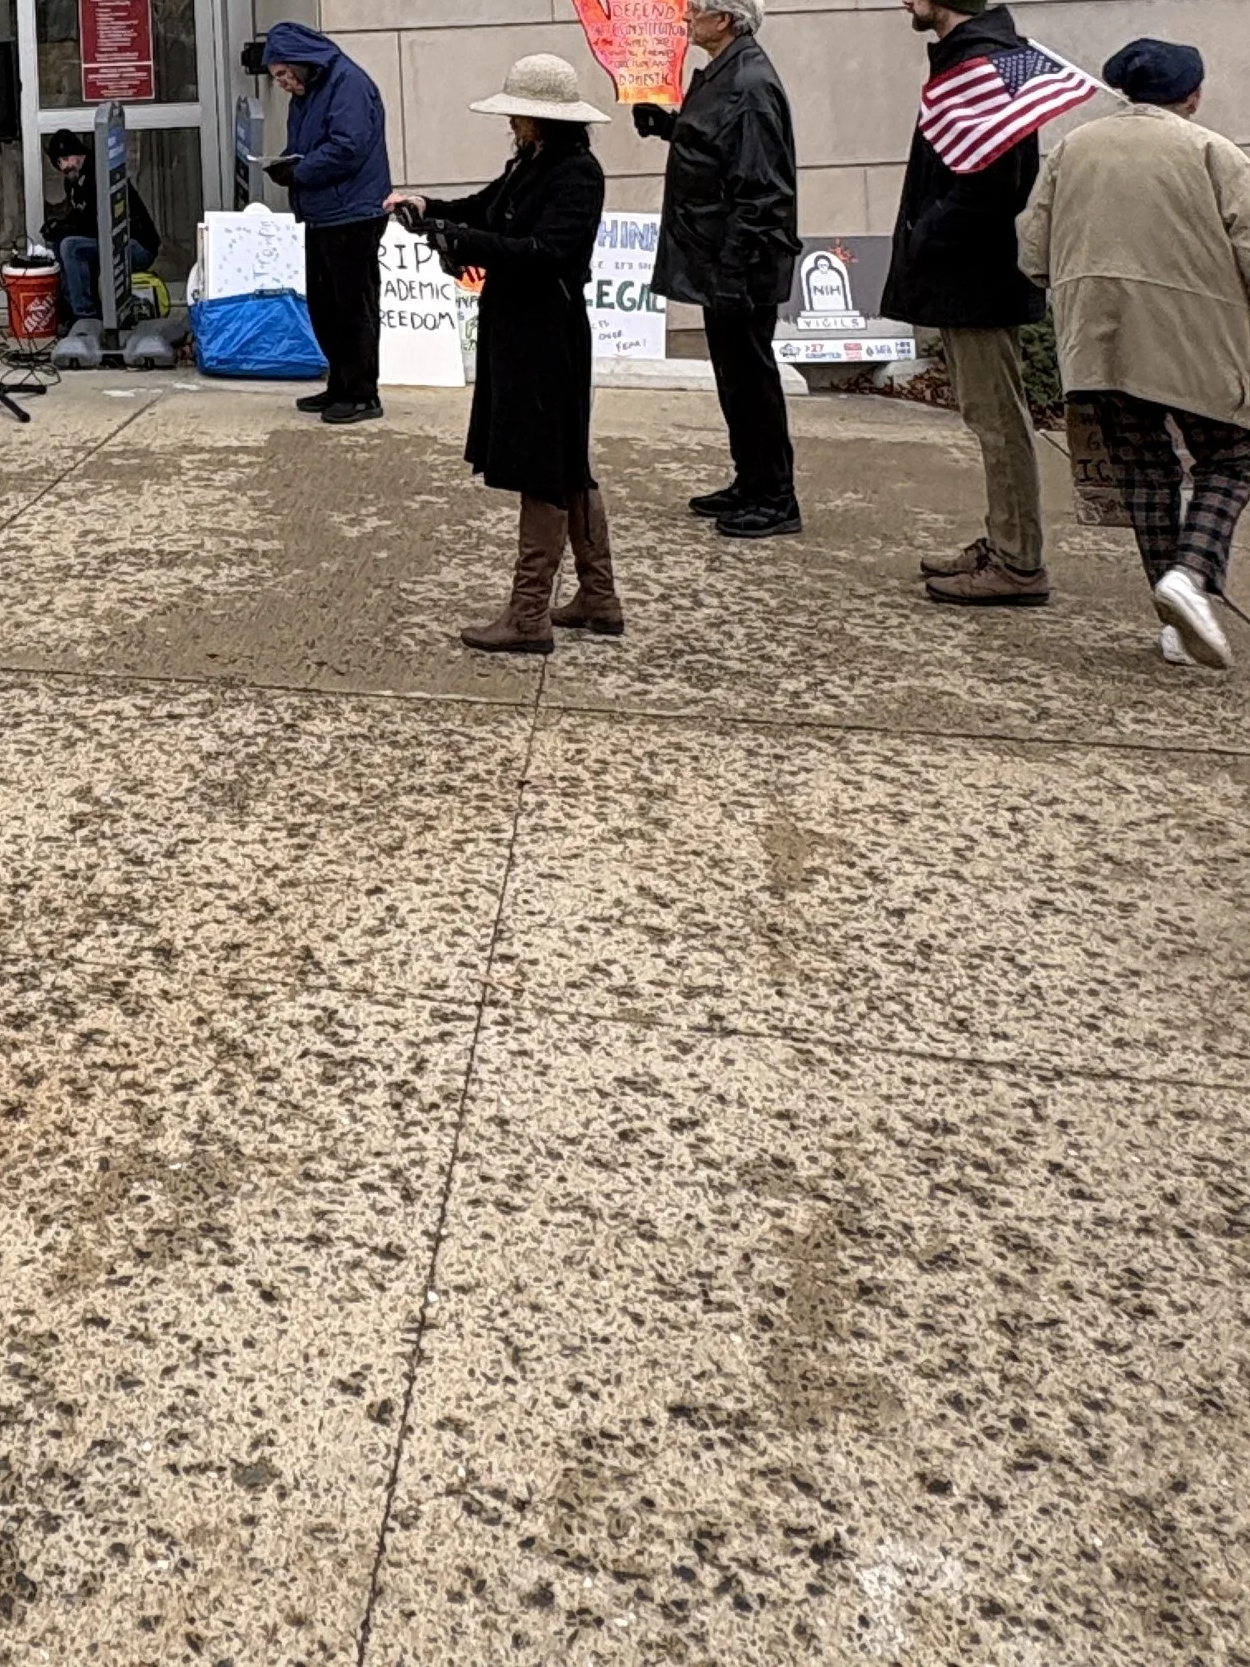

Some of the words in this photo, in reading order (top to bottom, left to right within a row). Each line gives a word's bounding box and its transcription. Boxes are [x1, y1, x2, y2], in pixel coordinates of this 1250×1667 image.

[612, 3, 675, 19] DEFEND
[384, 278, 452, 301] ADEMIC
[586, 279, 666, 313] EGAL
[813, 285, 841, 296] NIH
[380, 310, 456, 330] REEDOM
[804, 319, 859, 328] VIGILS
